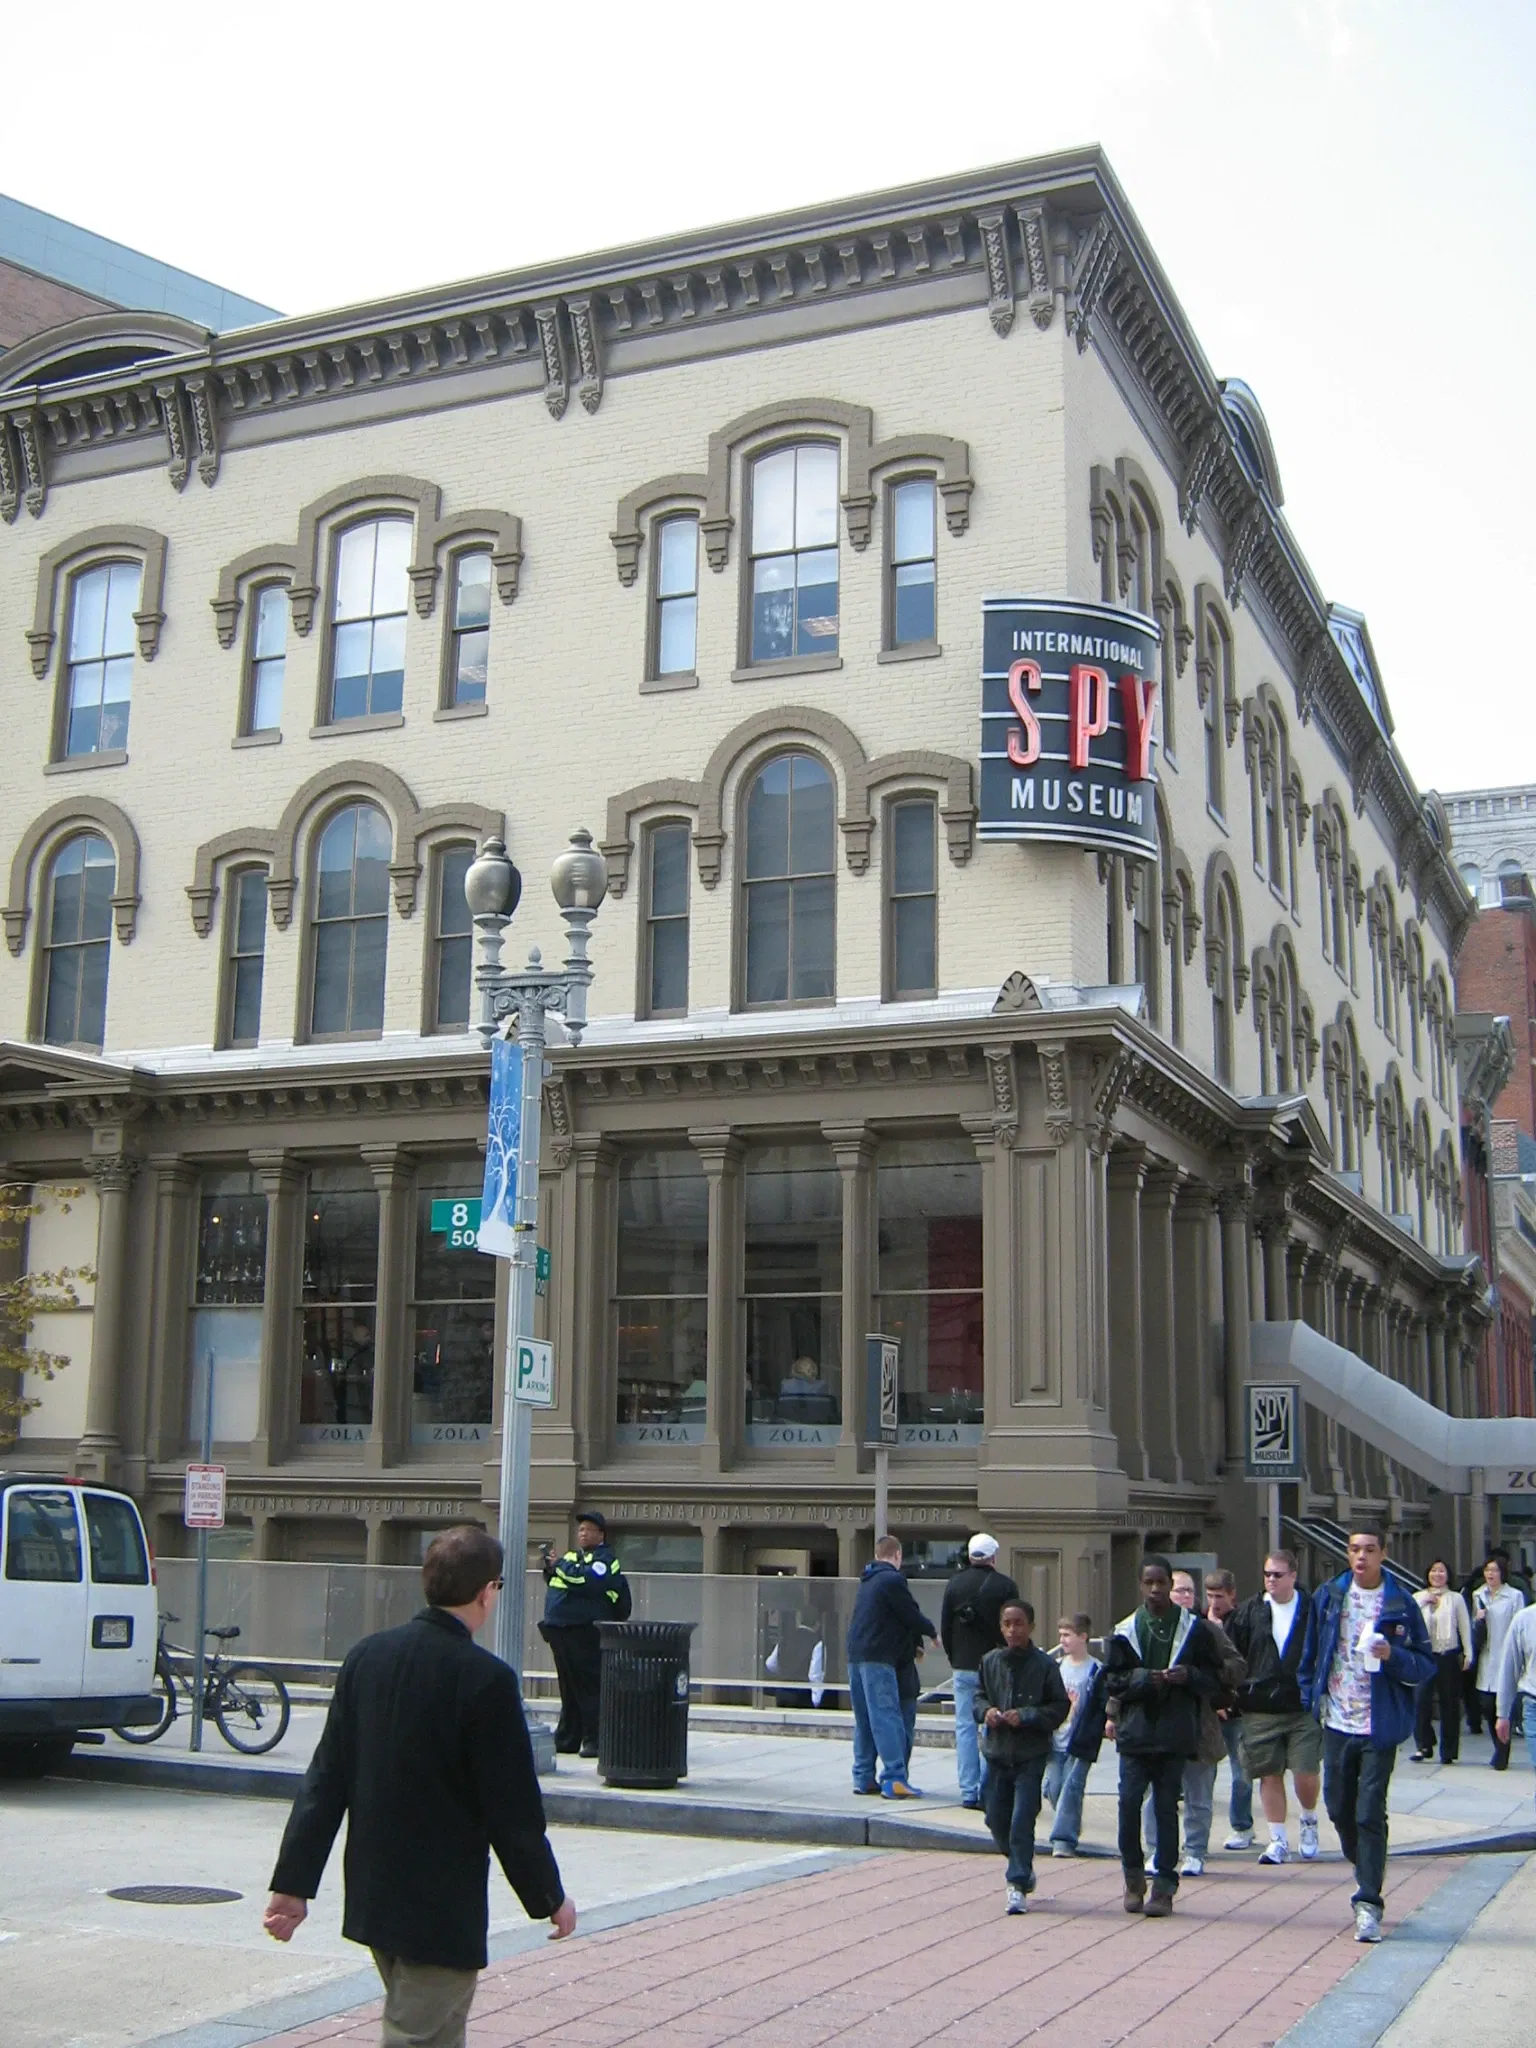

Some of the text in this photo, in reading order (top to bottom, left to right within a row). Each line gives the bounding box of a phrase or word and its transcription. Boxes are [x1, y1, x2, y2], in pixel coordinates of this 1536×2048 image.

[1013, 630, 1144, 670] INTERNATIONAL
[1007, 658, 1159, 782] SPY
[1011, 778, 1144, 826] MUSEUM
[451, 1203, 468, 1227] 8
[451, 1229, 481, 1247] 50
[1254, 1396, 1289, 1432] SPY
[319, 1427, 365, 1441] ZOLA
[433, 1427, 481, 1441] ZOLA
[638, 1427, 690, 1441] ZOLA
[768, 1428, 823, 1443] ZOLA
[904, 1428, 960, 1443] ZOLA
[1254, 1450, 1290, 1461] MUSEUM
[303, 1498, 331, 1512] SPY
[341, 1499, 405, 1514] MUSEUM
[415, 1501, 464, 1515] STORE
[611, 1503, 954, 1523] INTERNATIONAL SPY MUSEU STORE
